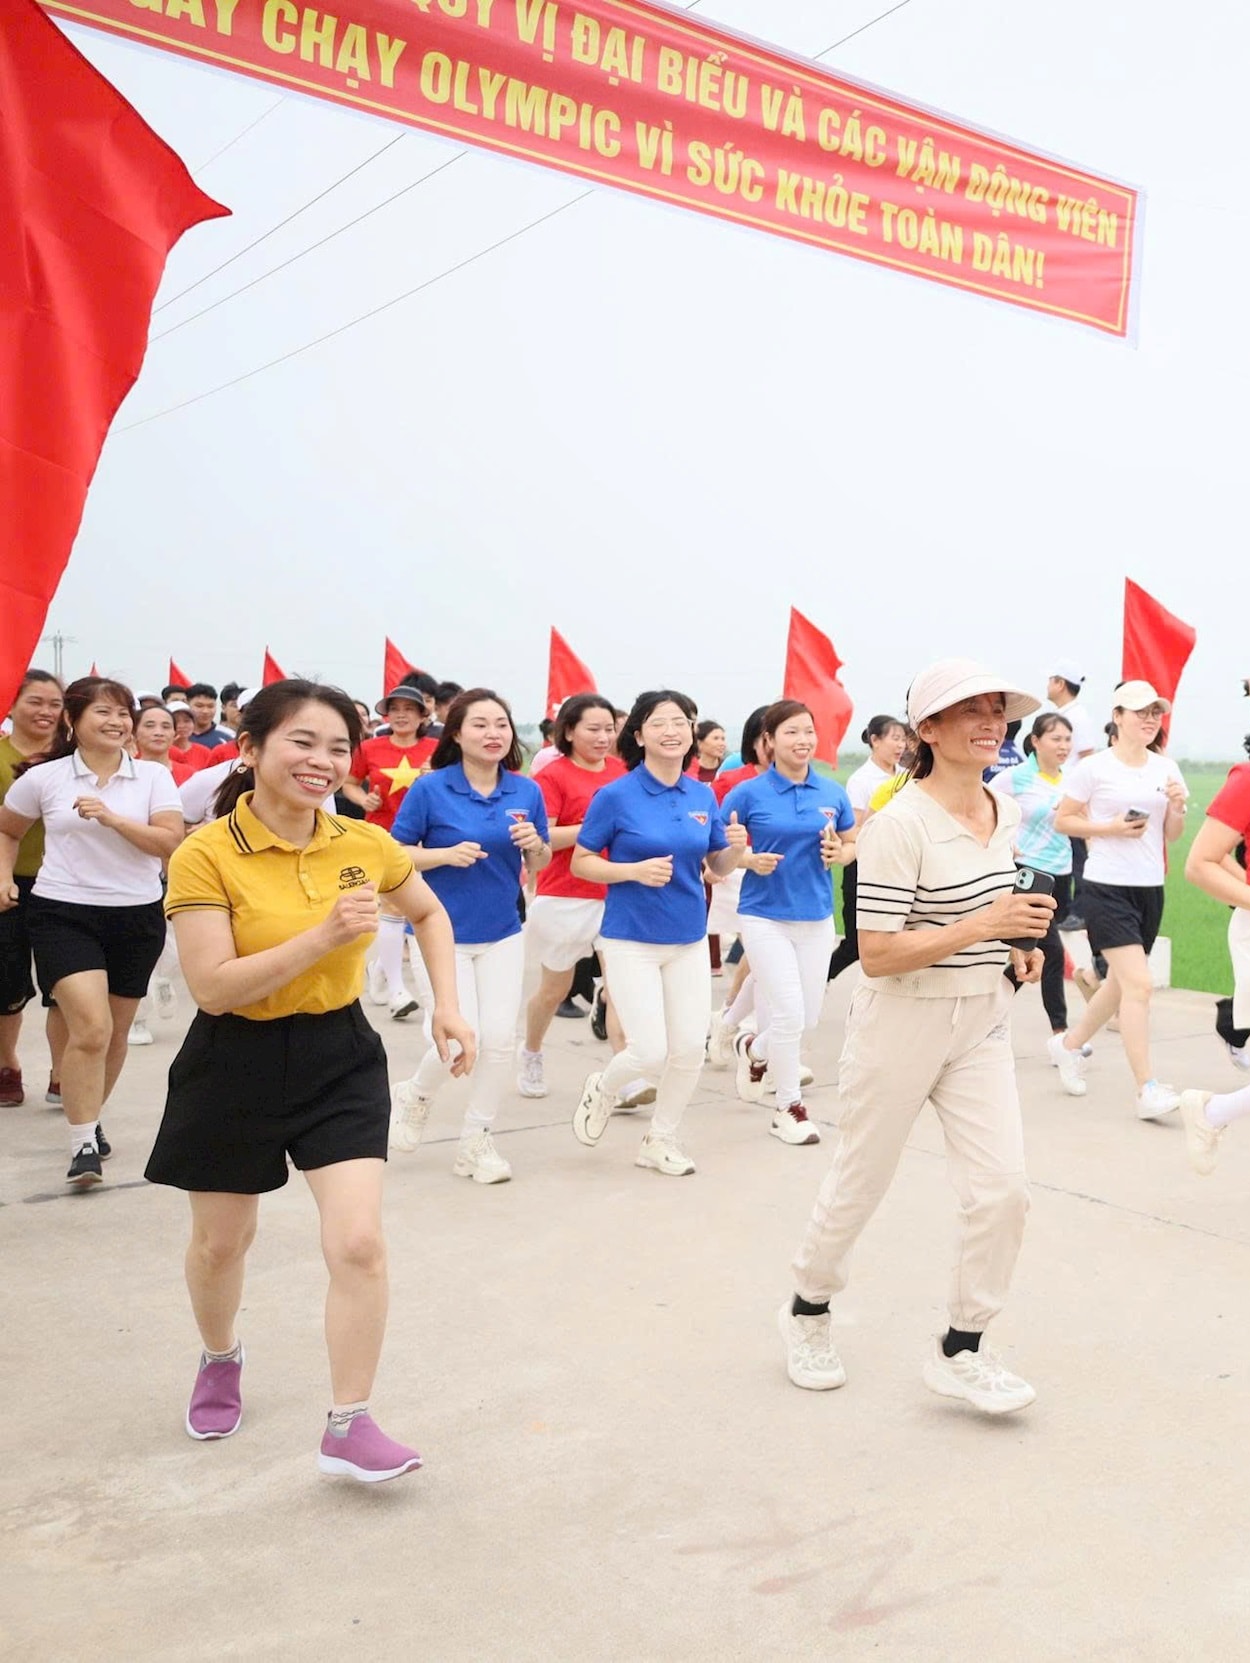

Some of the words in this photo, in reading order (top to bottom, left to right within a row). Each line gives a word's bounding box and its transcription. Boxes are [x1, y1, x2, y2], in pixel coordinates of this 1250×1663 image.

[262, 0, 406, 89] CHẠY
[420, 51, 622, 158] OLYMPIC
[636, 120, 673, 176] VÌ
[687, 142, 765, 202] SỨC
[775, 173, 870, 235] KHỎE
[880, 201, 964, 264] TOÀN
[972, 232, 1045, 289] DÂN!
[516, 0, 558, 62] VỊ
[571, 13, 645, 86] ĐẠI
[657, 46, 749, 119] BIỂU
[761, 85, 806, 141] VÀ
[818, 109, 887, 167] CÁC
[896, 136, 961, 194] VẬN
[1056, 193, 1118, 248] VIÊN
